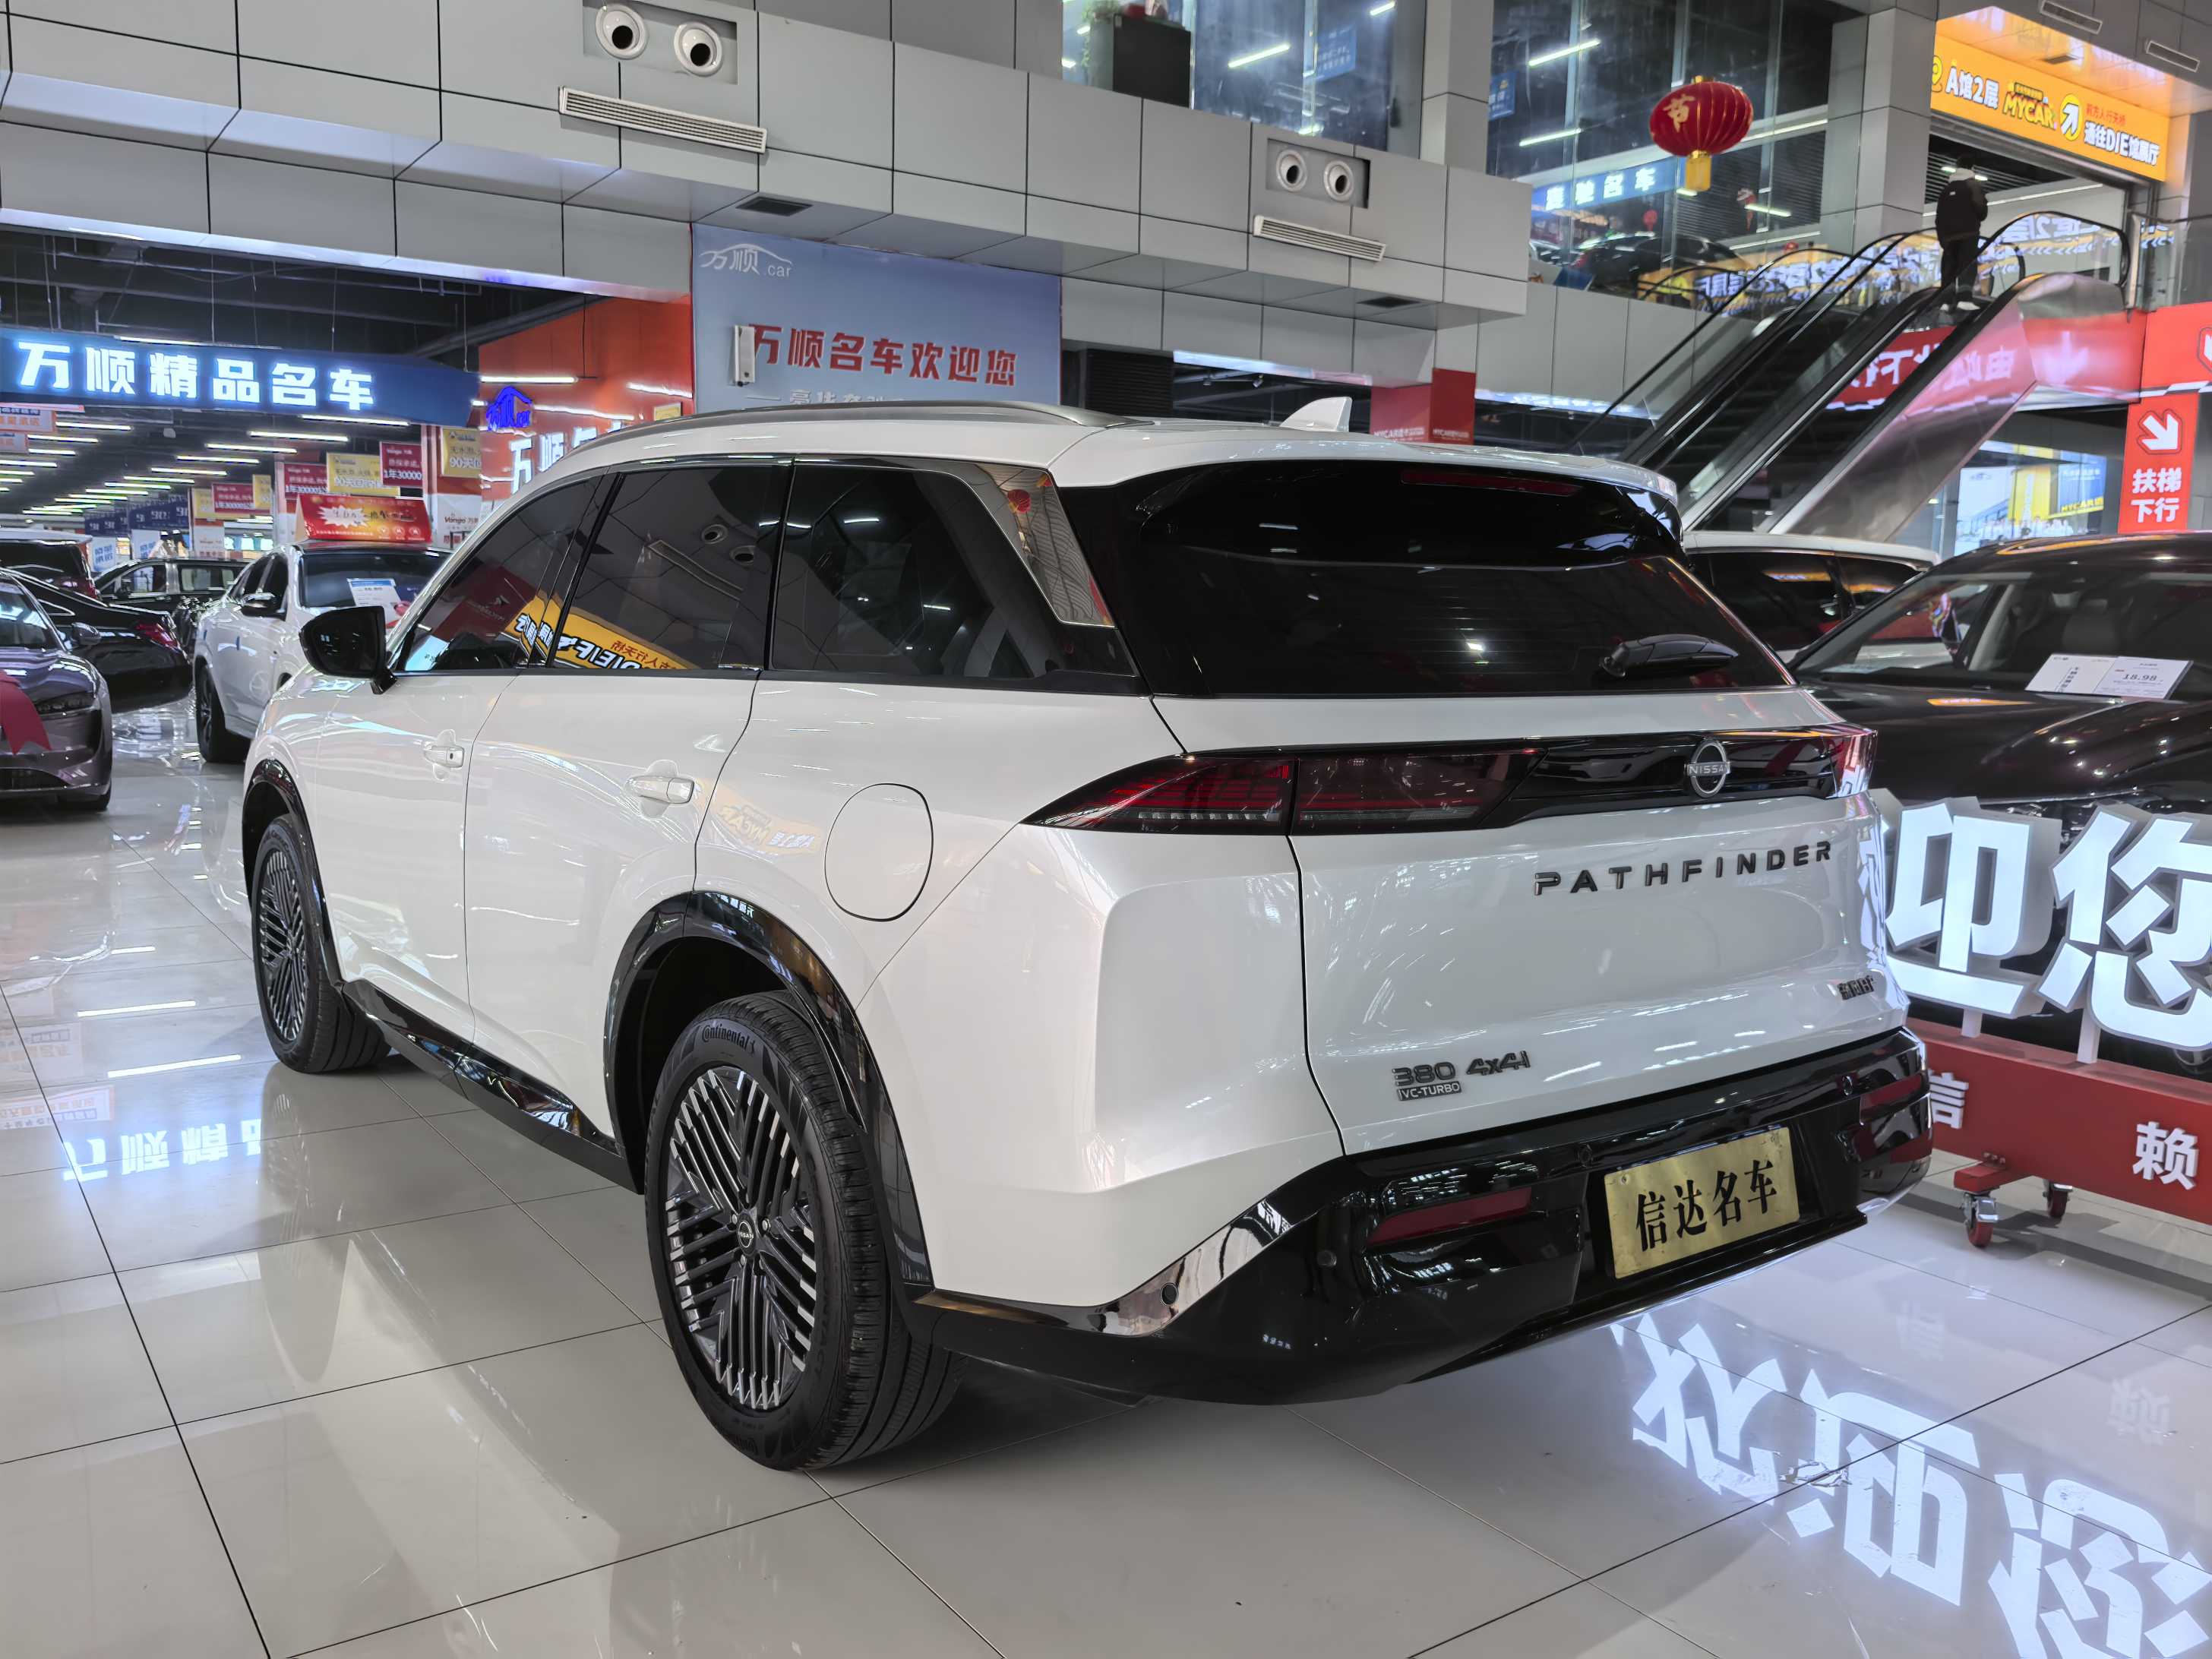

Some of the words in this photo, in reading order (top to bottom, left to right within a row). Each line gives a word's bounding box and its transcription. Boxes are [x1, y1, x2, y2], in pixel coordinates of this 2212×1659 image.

[1945, 65, 1999, 109] A馆2层
[2003, 91, 2056, 130] MYCAR
[17, 340, 375, 412] 万顺精品名车
[747, 323, 1018, 386] 万顺名车欢迎您
[2132, 467, 2182, 494] 扶梯
[2130, 498, 2180, 523] 下行
[1534, 840, 1832, 896] PATHFINDER
[1885, 802, 2212, 1048] 迎您
[702, 1023, 750, 1051] Continental
[1392, 1061, 1456, 1087] 380
[1403, 1082, 1461, 1099] VC-TURBO
[1928, 1070, 1969, 1129] 信
[2133, 1121, 2199, 1190] 赖
[1635, 1158, 1778, 1252] 信达名车
